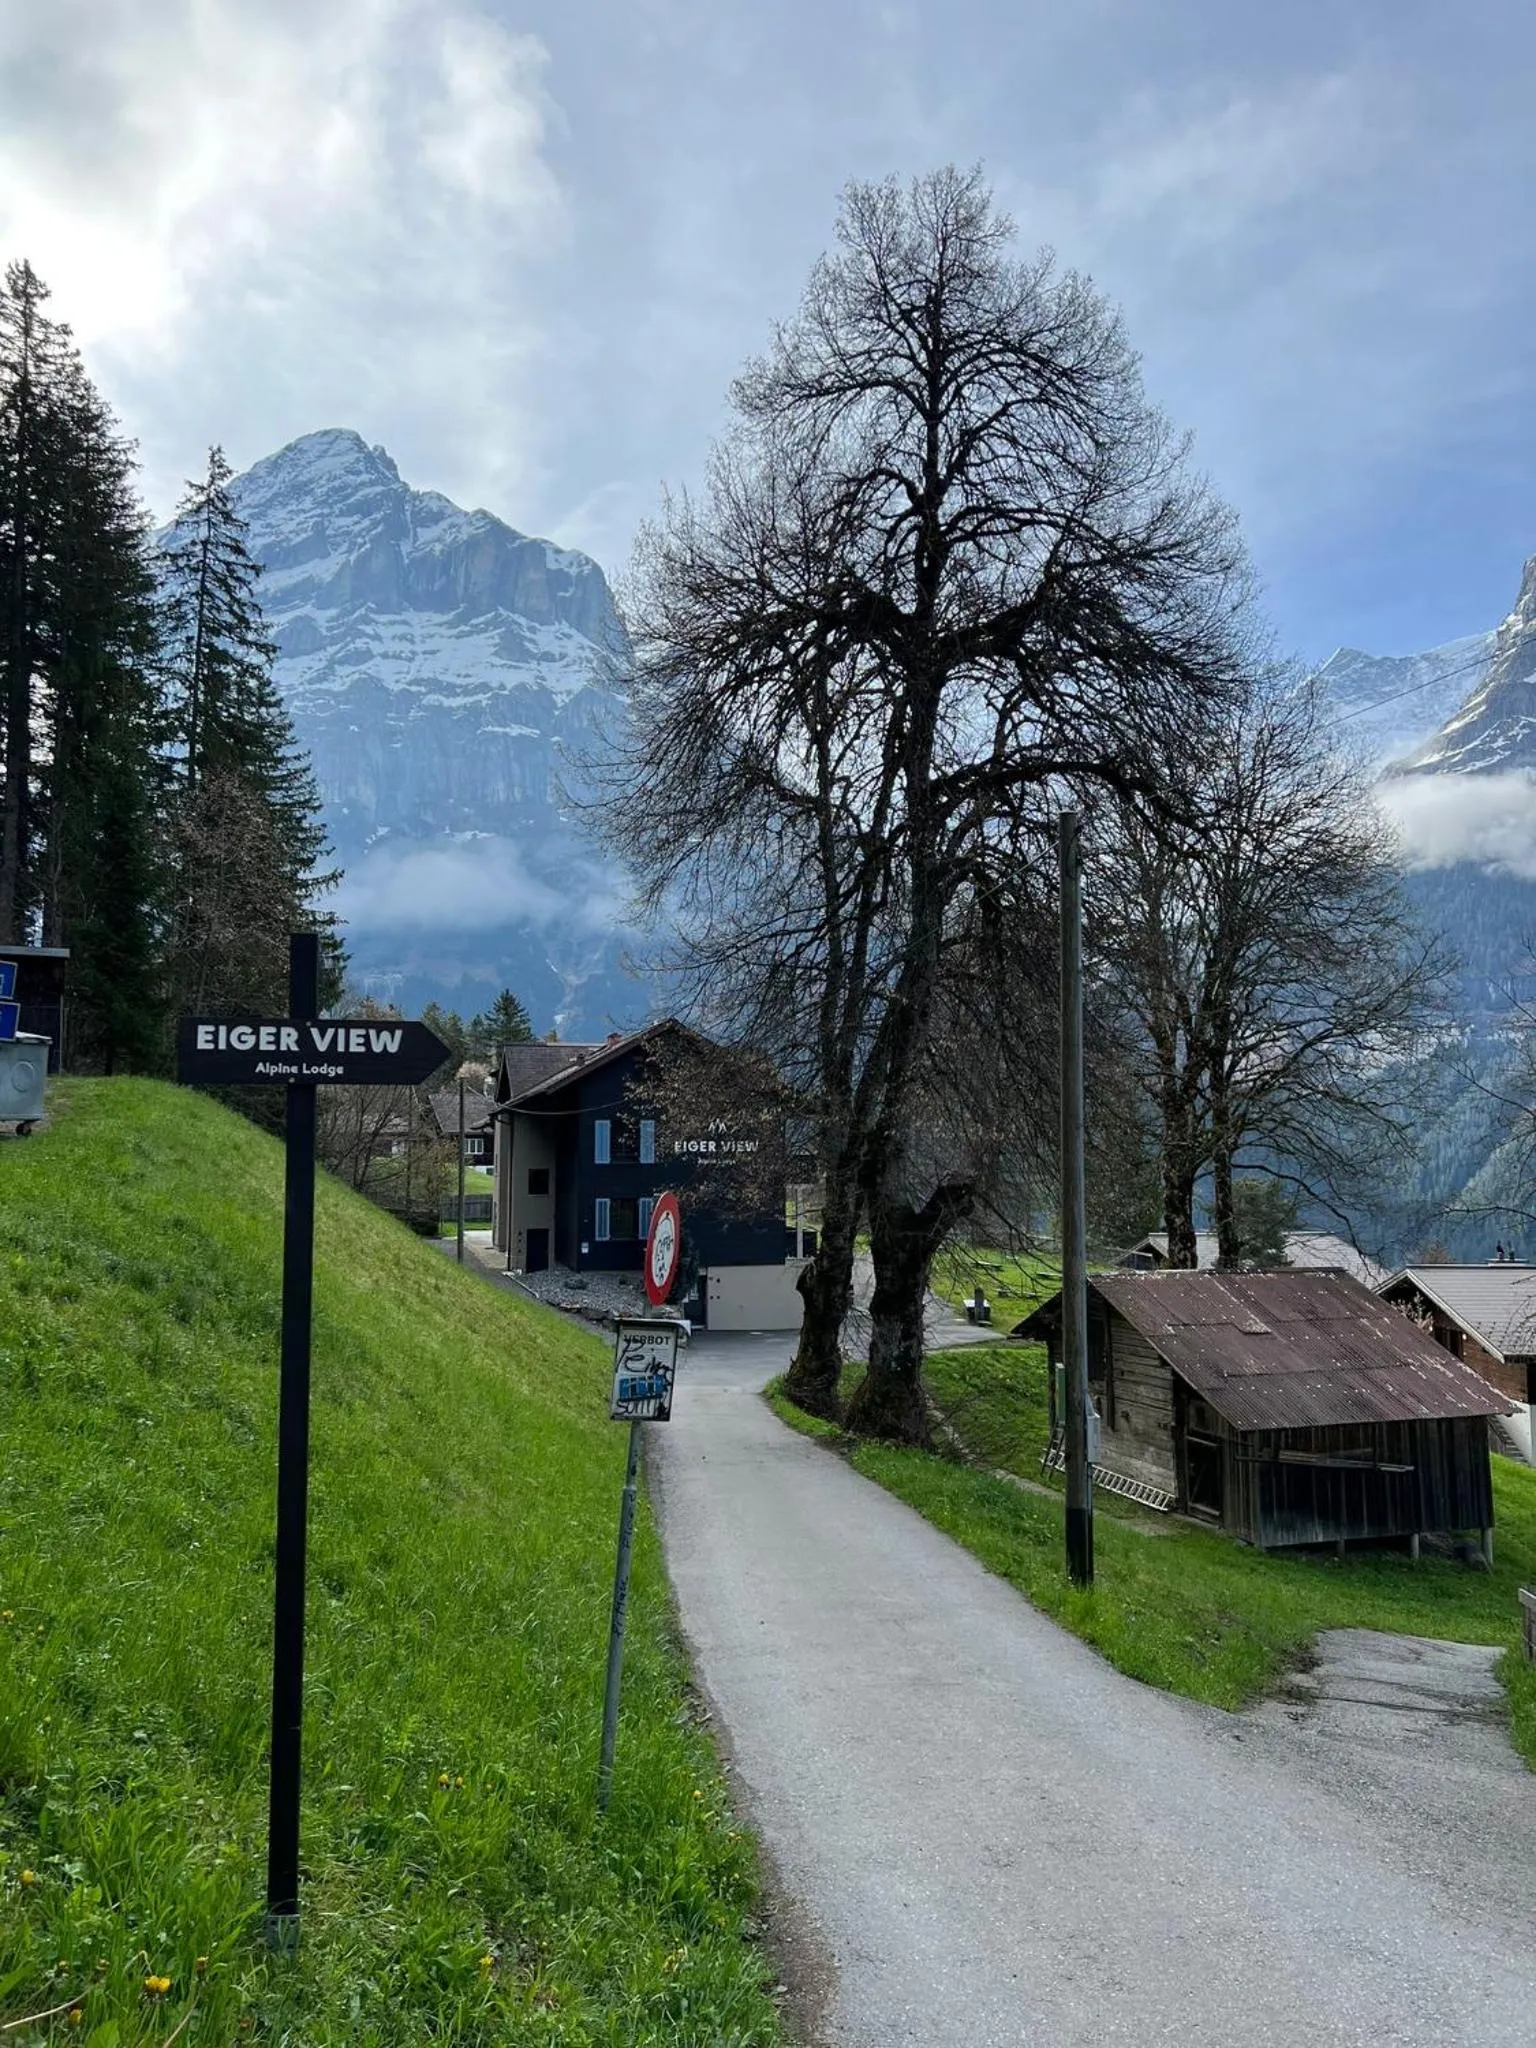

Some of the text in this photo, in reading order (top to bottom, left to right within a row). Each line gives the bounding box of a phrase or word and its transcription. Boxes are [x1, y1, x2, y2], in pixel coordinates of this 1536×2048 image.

[196, 1025, 403, 1053] EIGER VIEW
[255, 1062, 344, 1077] Alpine Lodge
[674, 1140, 759, 1153] EIGER VIEW
[623, 1334, 670, 1346] VERBOT
